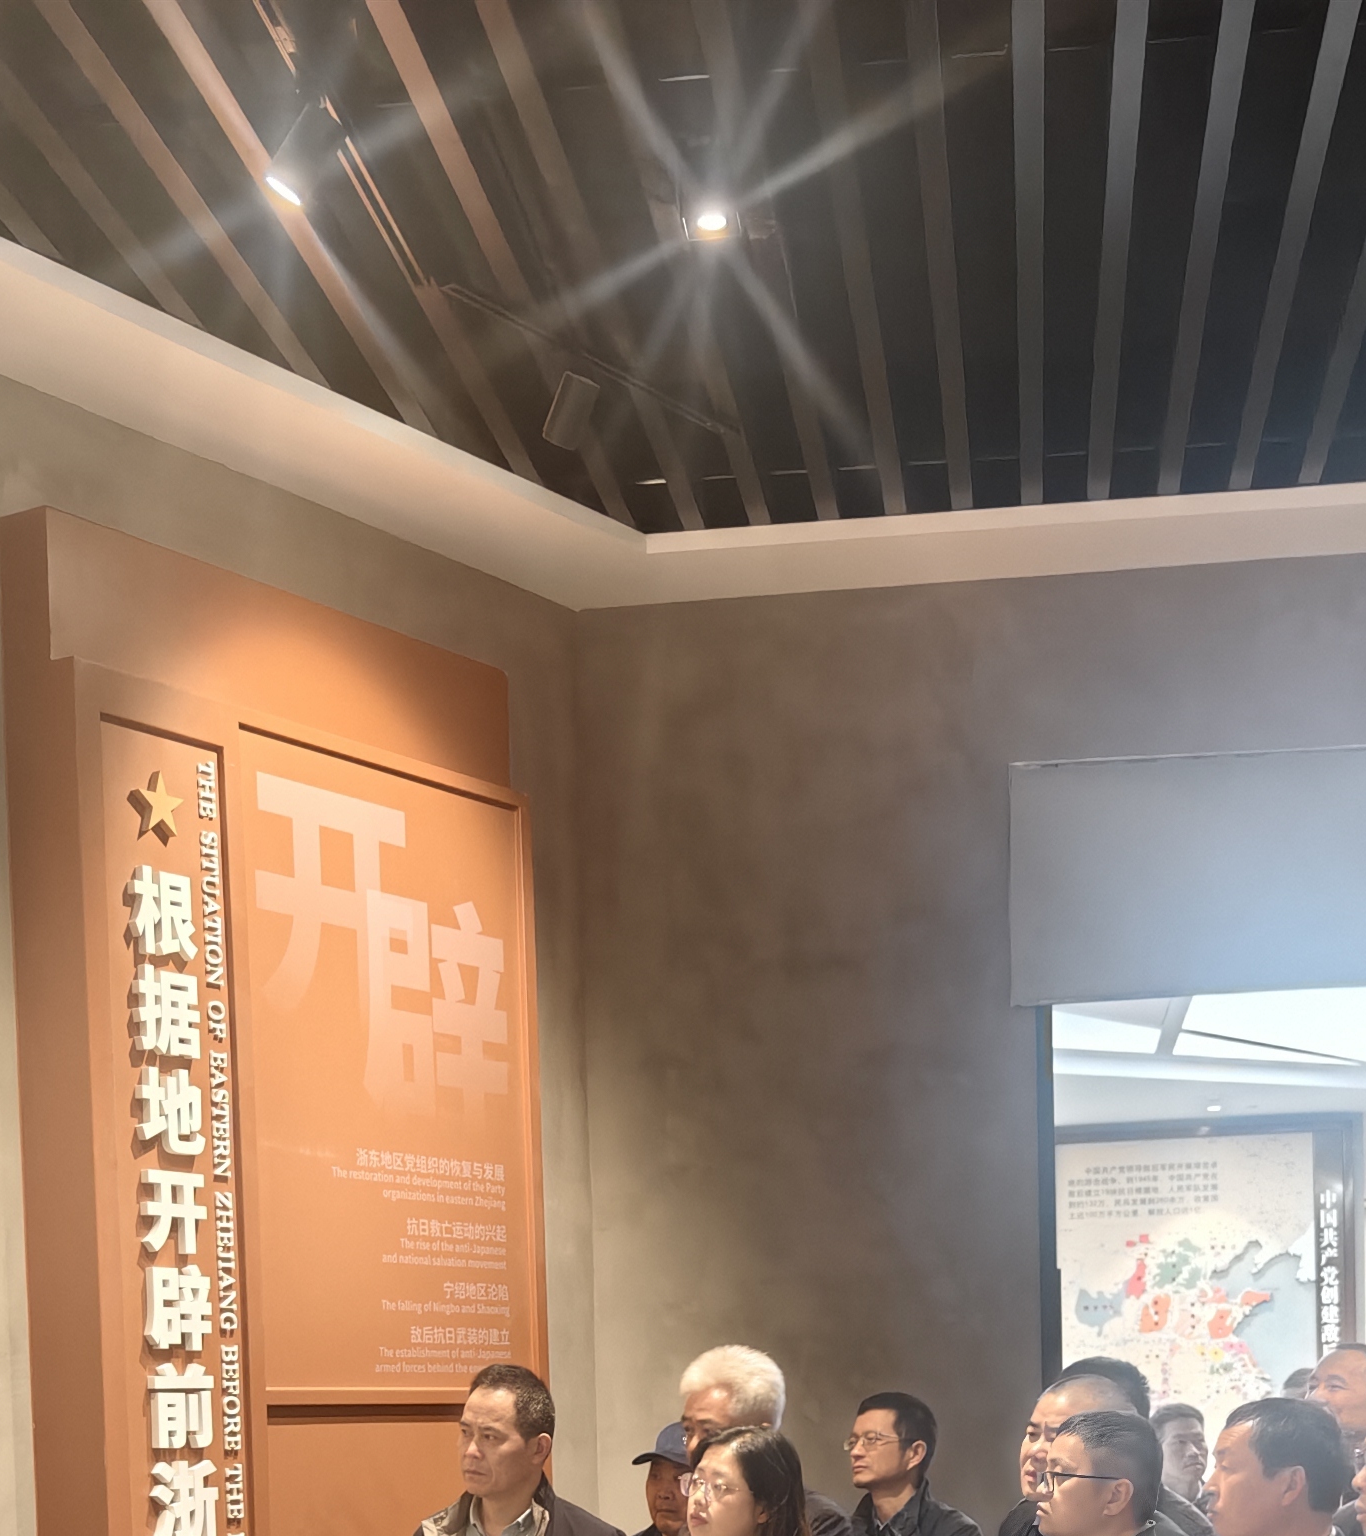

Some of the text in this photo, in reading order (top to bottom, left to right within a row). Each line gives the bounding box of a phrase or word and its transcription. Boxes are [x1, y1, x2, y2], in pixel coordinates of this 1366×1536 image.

[198, 761, 217, 820] THE
[200, 830, 225, 990] SITUATION
[255, 770, 509, 1115] 开辟
[207, 1000, 227, 1042] OF
[209, 1050, 232, 1180] EASTERN
[356, 1148, 505, 1182] 浙东地区党组织的恢复与发展
[332, 1166, 505, 1197] The restoration and development of the Party
[383, 1189, 506, 1211] organizations in eastern Zhejiang
[400, 1238, 414, 1249] The
[416, 1240, 430, 1250] rise
[431, 1240, 440, 1251] of
[441, 1241, 454, 1252] the
[407, 1218, 507, 1242] 抗日救亡运动的兴起
[215, 1191, 239, 1336] ZHEJIANG
[382, 1253, 397, 1264] and
[399, 1253, 431, 1265] national
[443, 1281, 509, 1301] 宁绍地区沦陷
[381, 1300, 510, 1317] The falling of Ningbo and Shaoxing
[411, 1326, 510, 1345] 敌后抗日武装的建立
[375, 1363, 400, 1373] armed
[402, 1362, 426, 1373] forces
[428, 1363, 454, 1373] behind
[455, 1364, 468, 1373] the
[379, 1346, 394, 1357] The
[396, 1347, 450, 1359] establishment
[451, 1348, 459, 1359] of
[220, 1344, 243, 1452] BEFORE
[225, 1463, 246, 1520] THE
